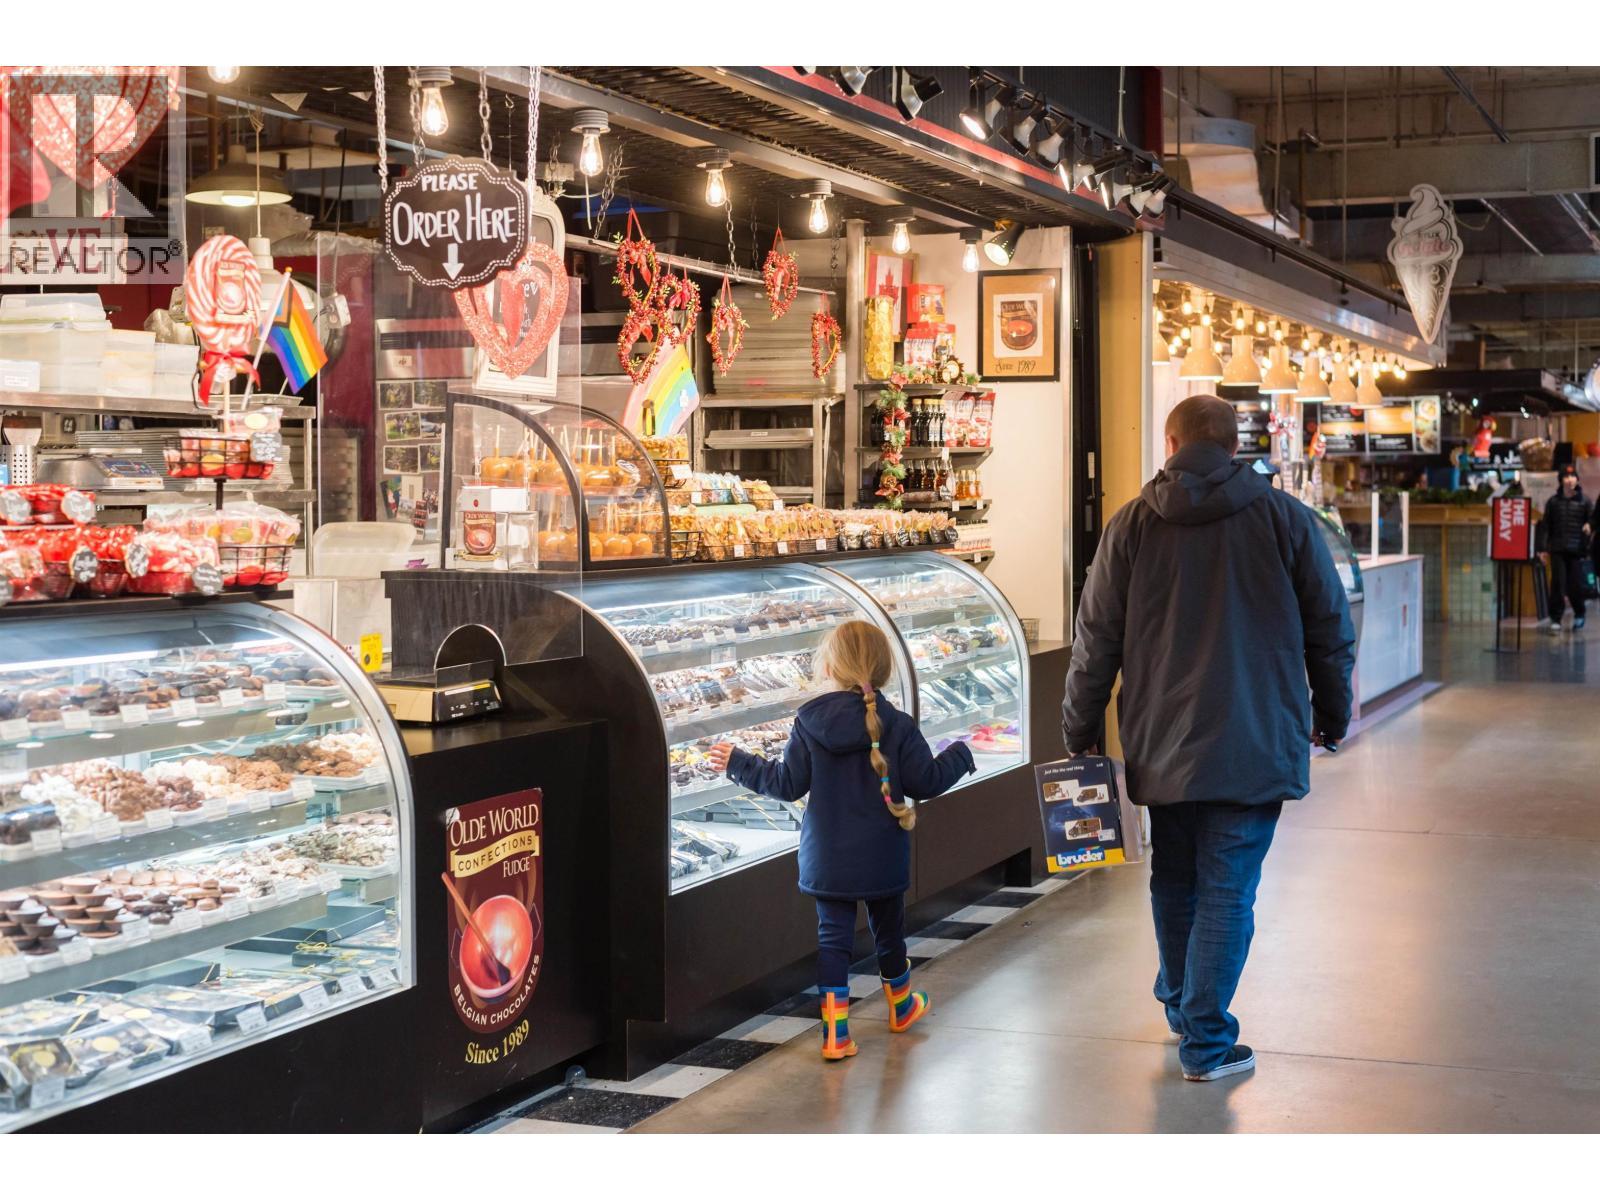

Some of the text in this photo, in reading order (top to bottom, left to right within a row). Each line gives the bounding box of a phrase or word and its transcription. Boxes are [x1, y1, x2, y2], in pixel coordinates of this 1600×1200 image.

[421, 172, 479, 193] PLEASE
[392, 192, 518, 248] ORDER HERE
[450, 803, 539, 847] OLDE WORLD
[457, 835, 533, 871] CONFECTIONS
[503, 856, 530, 878] FUDGE
[1057, 850, 1104, 866] bruder
[454, 954, 540, 1025] BELGIAN CHOCOLATES
[465, 1019, 530, 1064] Since 1989
